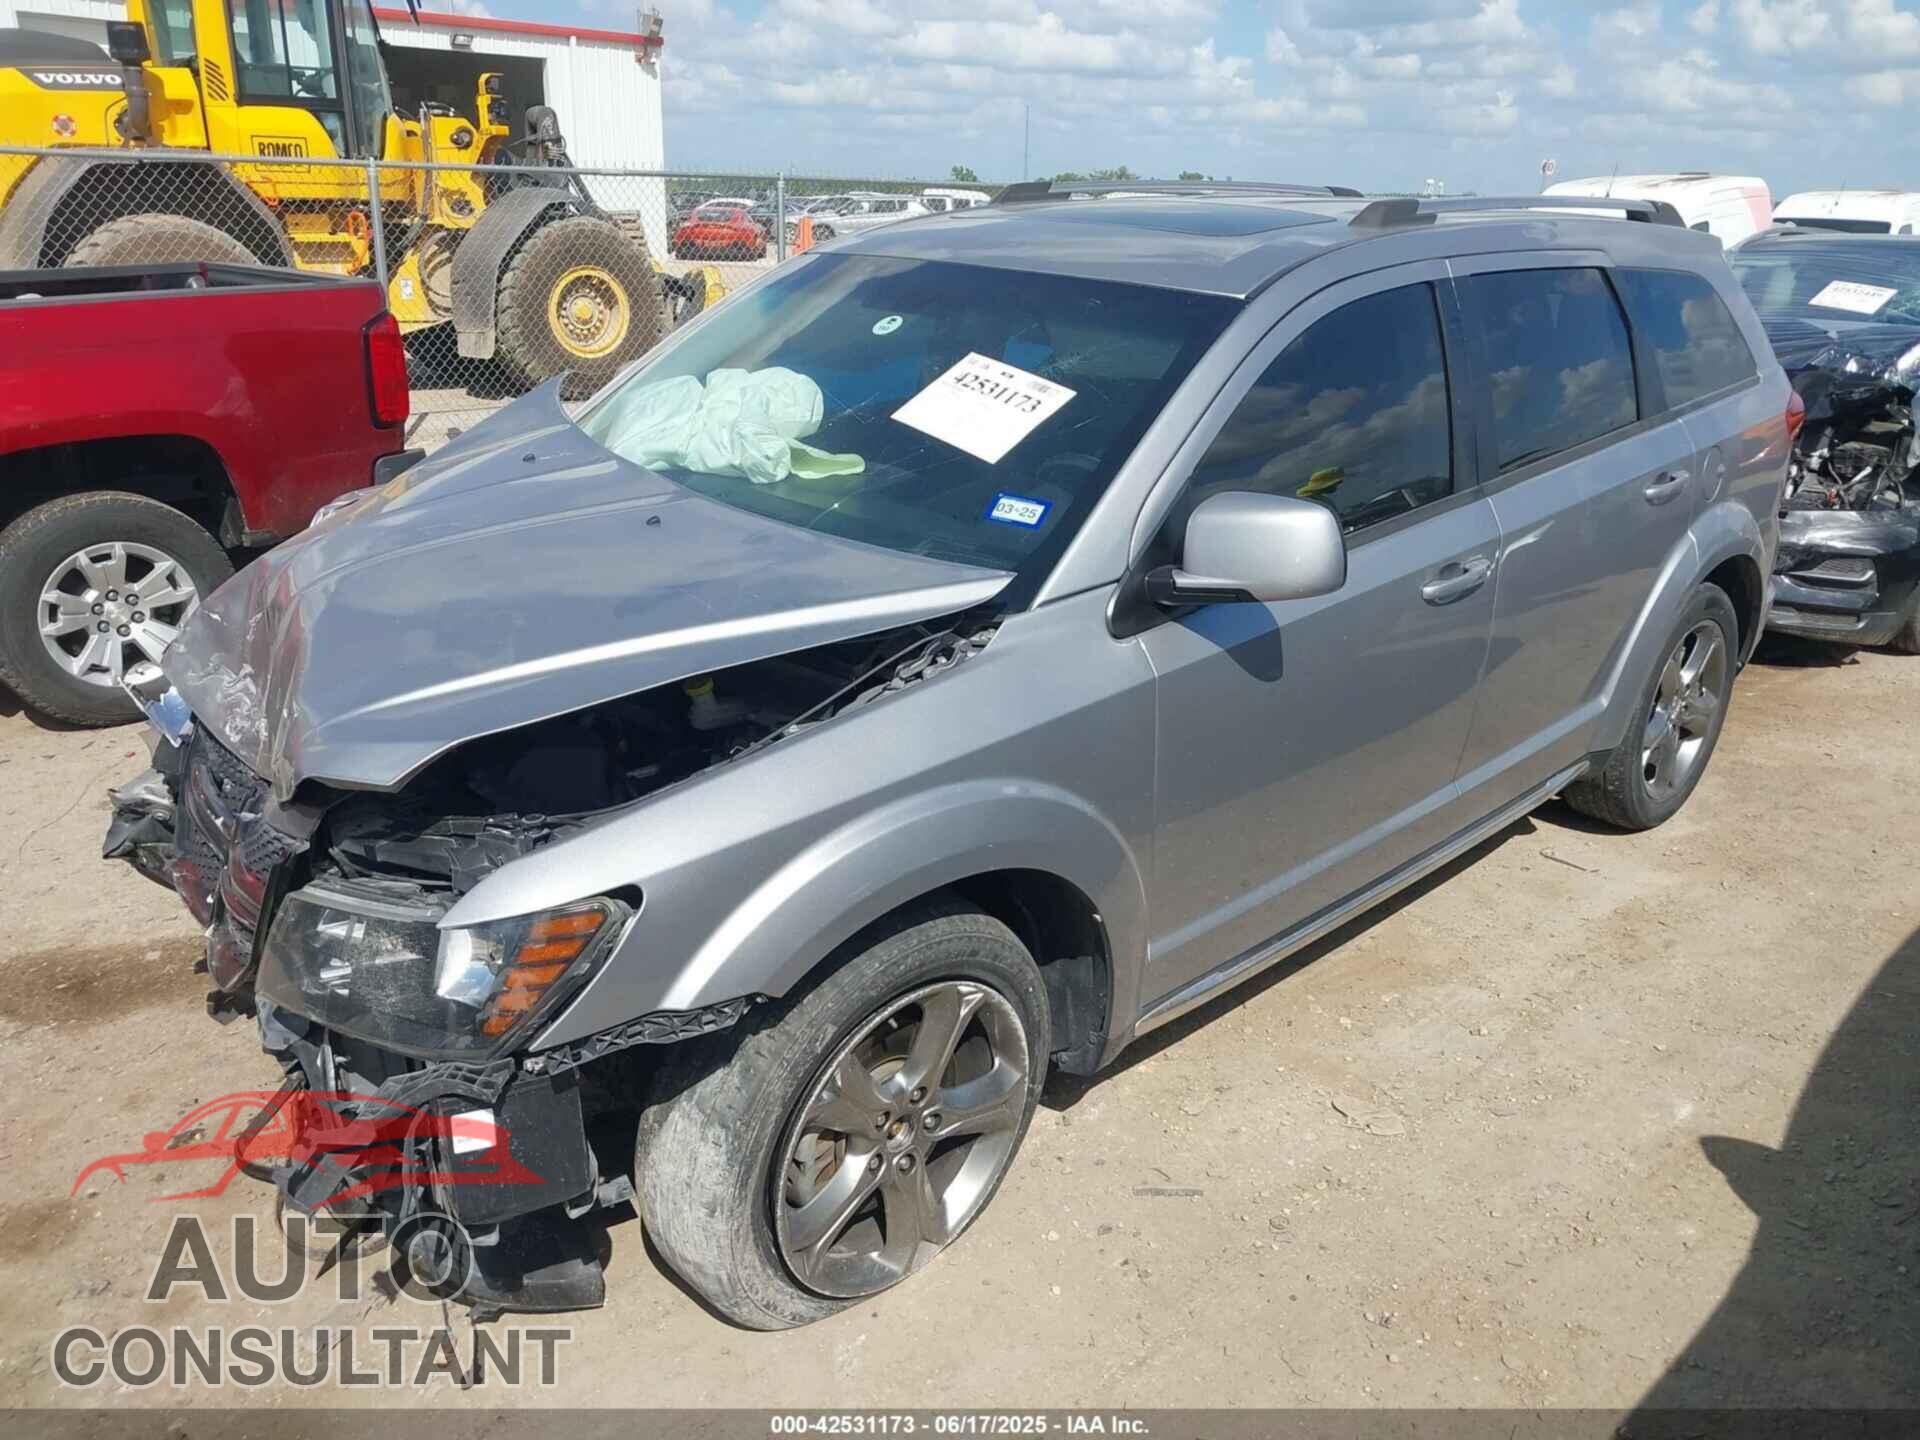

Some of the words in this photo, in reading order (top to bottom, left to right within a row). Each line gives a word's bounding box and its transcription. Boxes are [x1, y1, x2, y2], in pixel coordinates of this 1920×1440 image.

[33, 72, 122, 85] VOLVO
[258, 141, 304, 158] ROMCO
[954, 371, 1042, 413] 42531173
